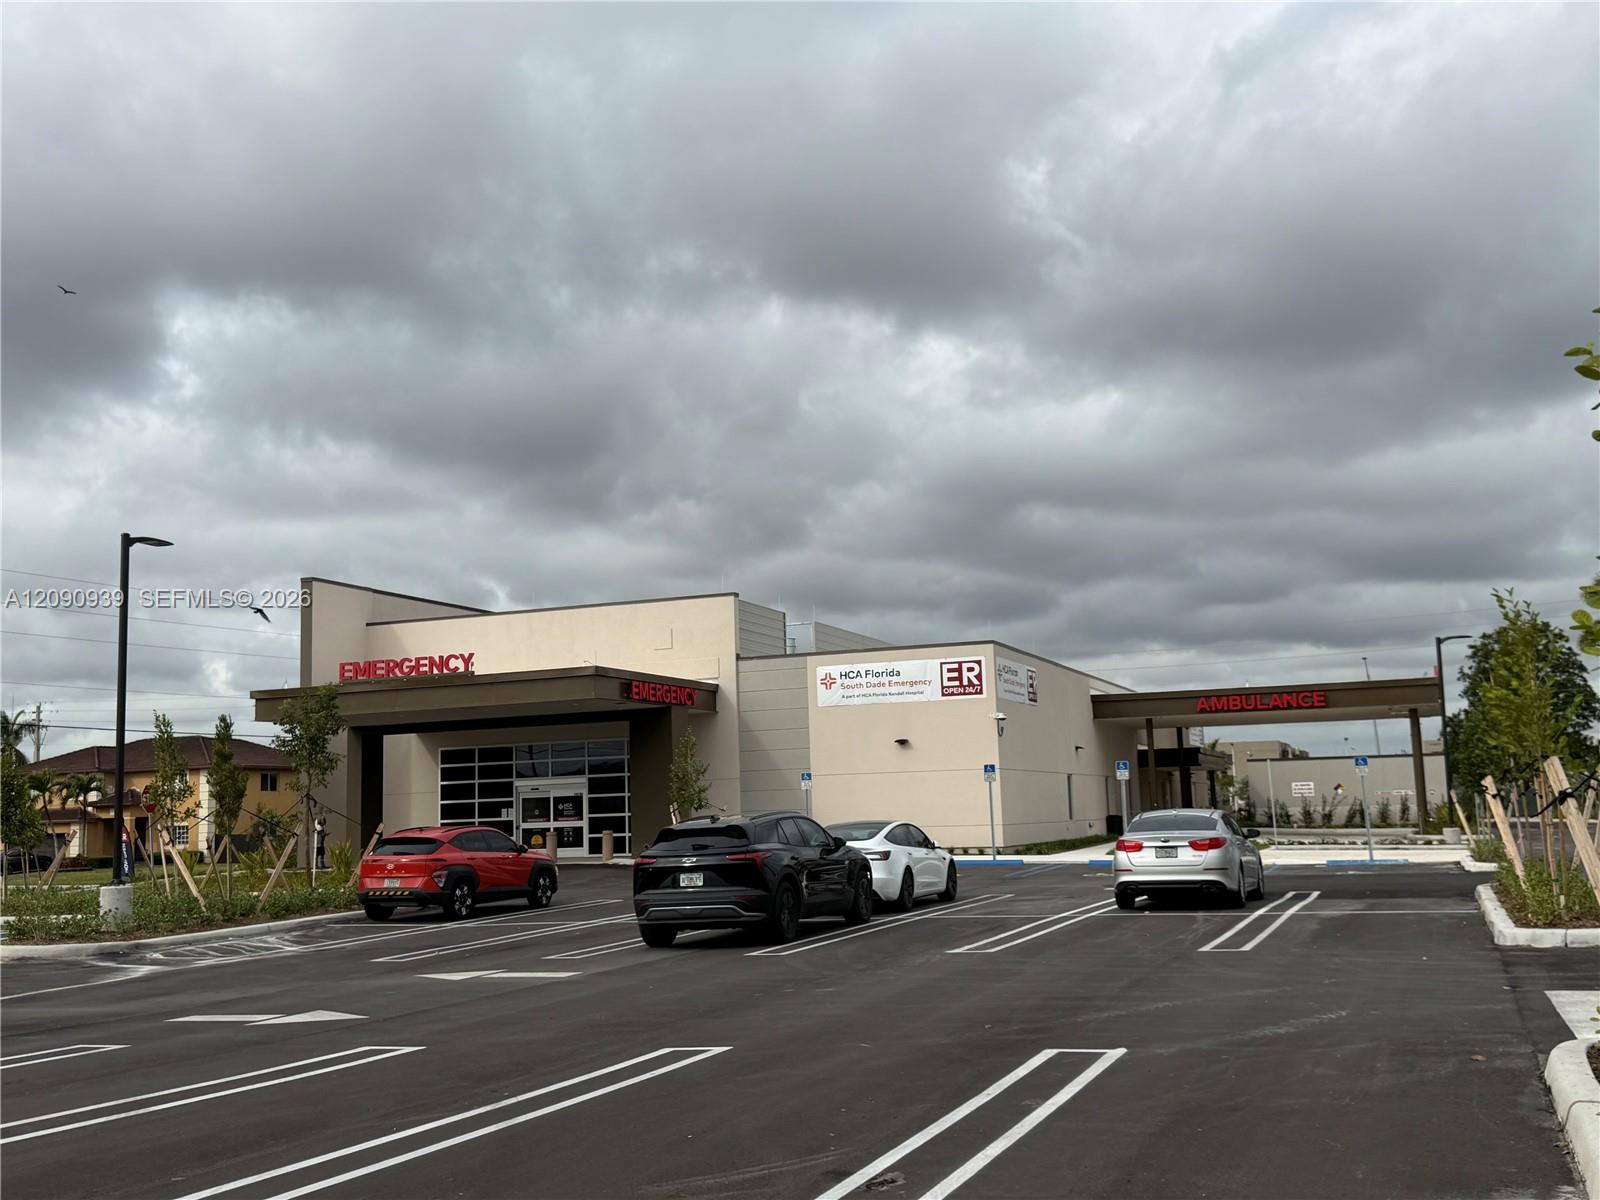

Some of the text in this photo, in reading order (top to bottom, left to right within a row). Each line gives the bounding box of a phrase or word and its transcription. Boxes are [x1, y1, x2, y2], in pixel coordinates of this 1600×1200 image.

[339, 652, 475, 680] EMERGENCY
[840, 668, 901, 680] HCA Florida
[941, 662, 981, 687] ER
[631, 680, 698, 705] EMERGENCY
[840, 679, 933, 690] South Dade Emergency
[1196, 691, 1326, 712] AMBULANCE
